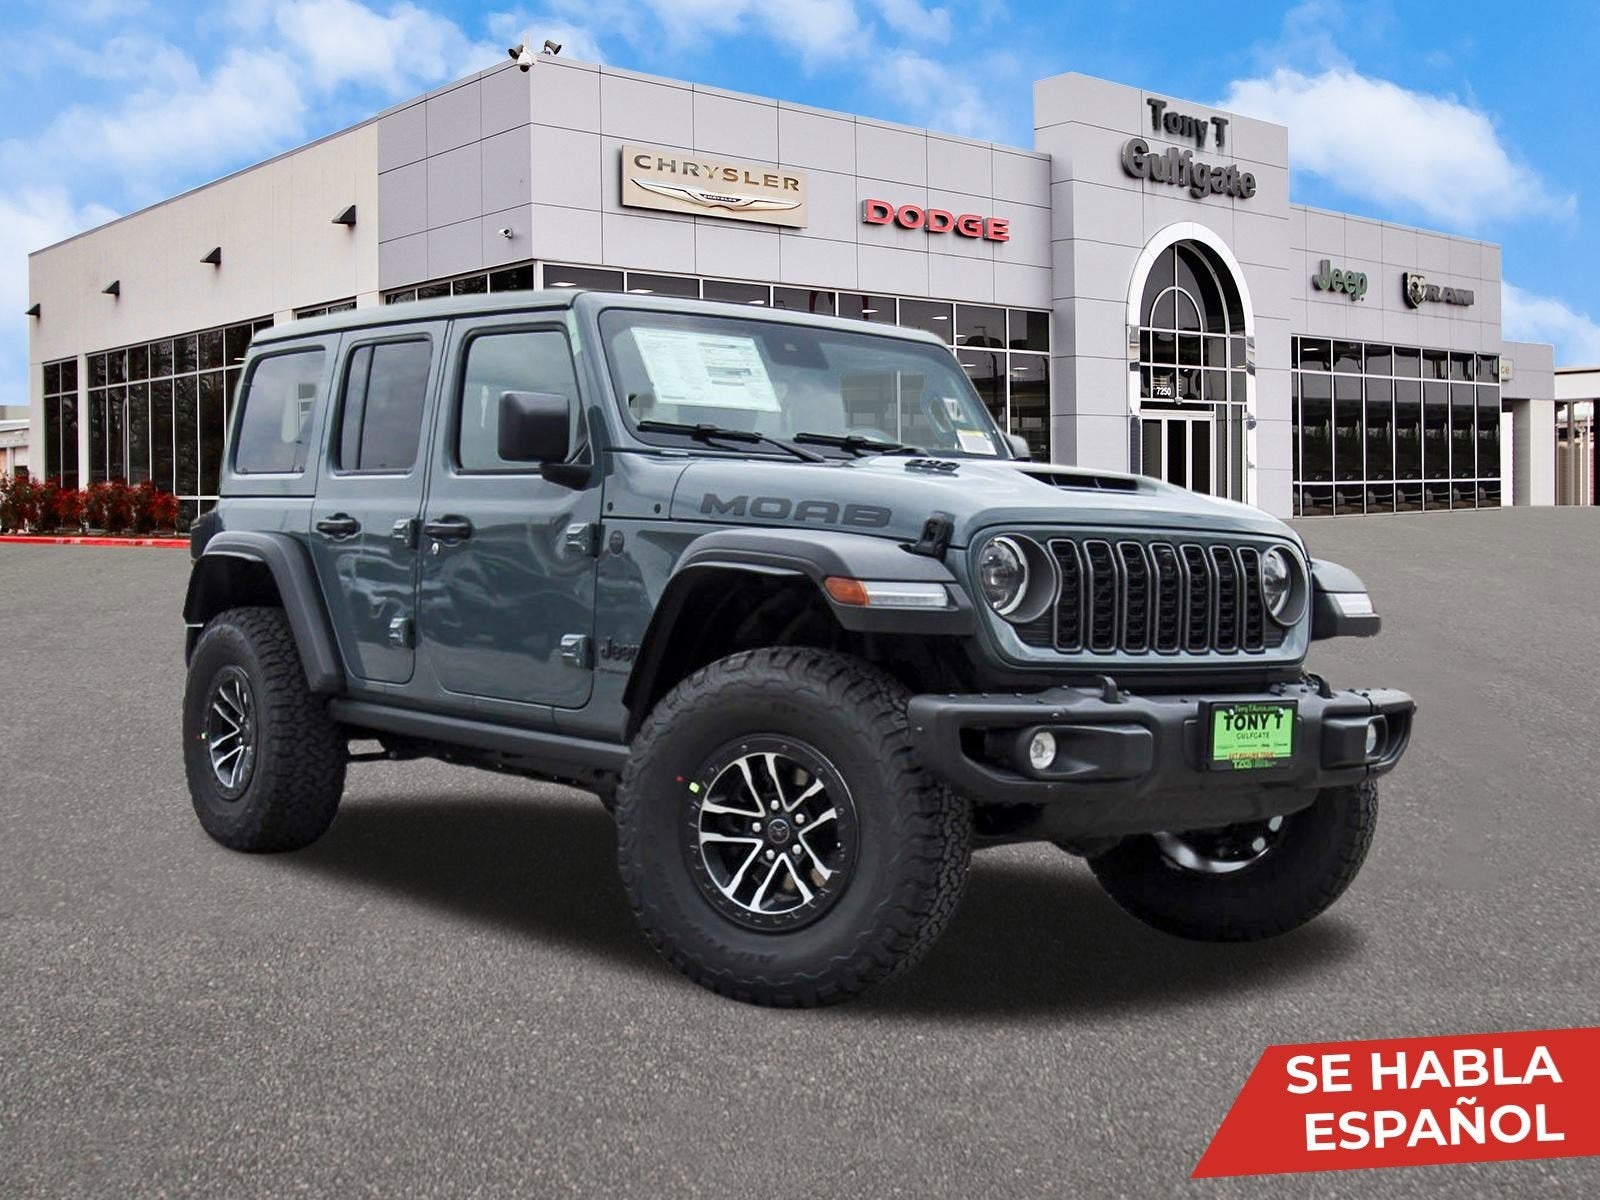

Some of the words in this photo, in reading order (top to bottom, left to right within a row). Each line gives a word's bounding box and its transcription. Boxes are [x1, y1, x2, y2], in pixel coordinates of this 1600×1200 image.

[1147, 98, 1208, 148] Tony
[1210, 116, 1229, 147] T
[634, 154, 800, 192] CHRYSLER
[1120, 138, 1256, 199] Gulfgate
[862, 199, 1010, 242] DODGE
[1312, 259, 1368, 301] Jeep
[1425, 284, 1474, 306] RAM
[1156, 386, 1171, 396] 7250
[700, 493, 892, 527] MOAB
[1223, 714, 1269, 731] TONY
[1274, 712, 1284, 729] T
